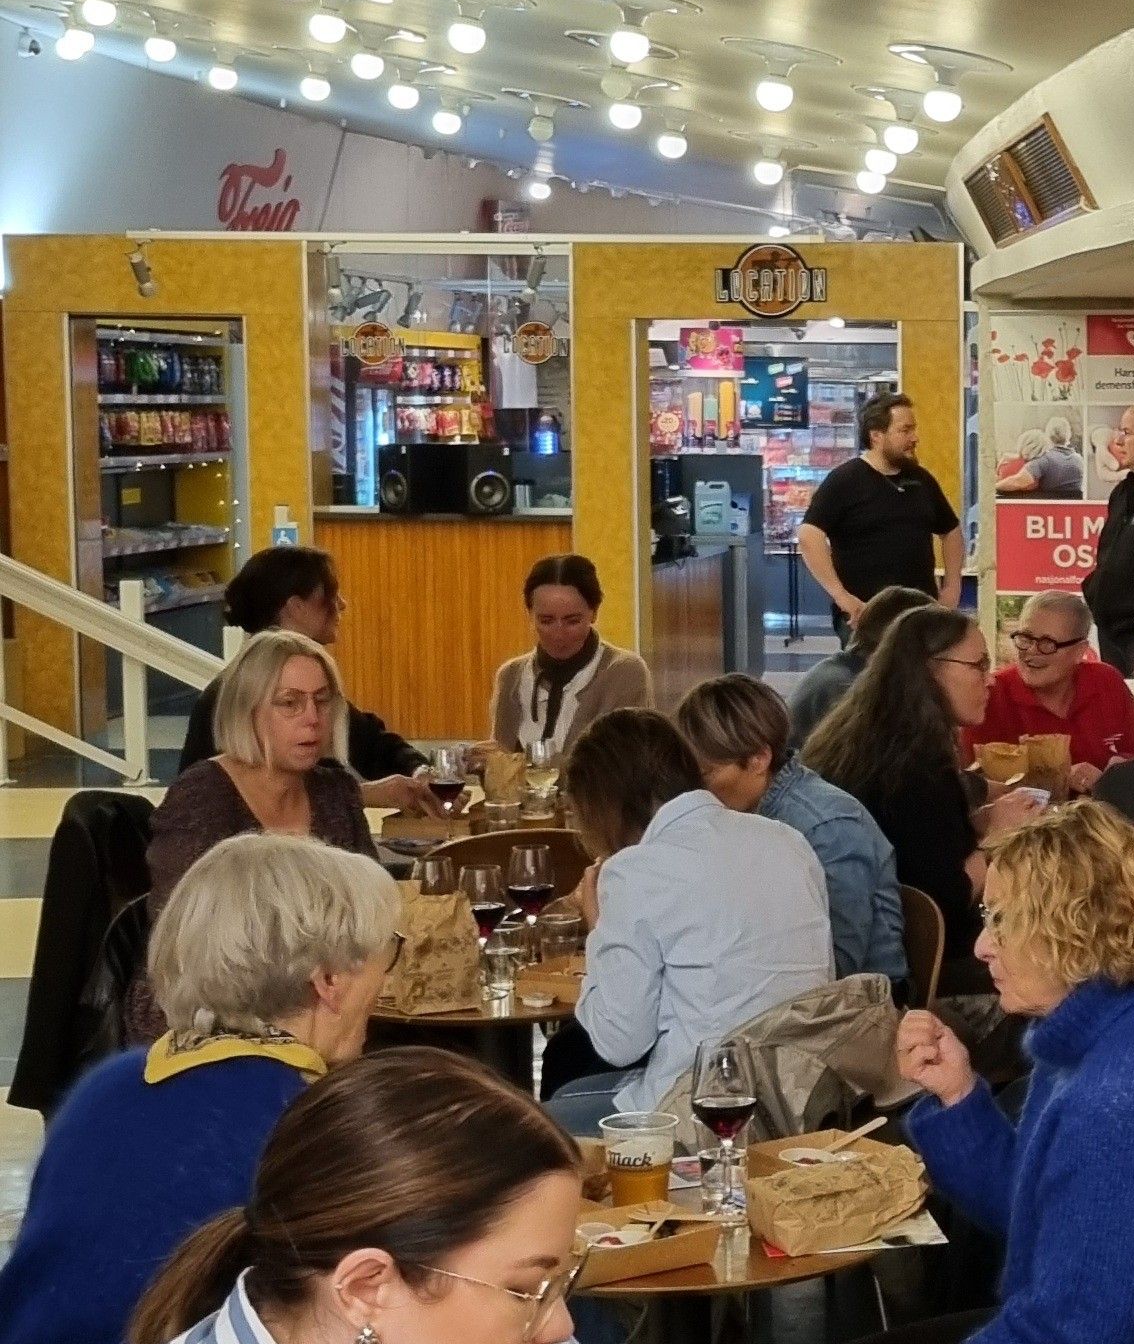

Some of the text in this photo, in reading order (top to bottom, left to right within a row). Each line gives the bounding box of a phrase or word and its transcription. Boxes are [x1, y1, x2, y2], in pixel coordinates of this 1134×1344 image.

[715, 268, 826, 302] LOCATION
[1026, 515, 1072, 539] BLI
[1083, 516, 1105, 539] M
[1053, 544, 1098, 568] OS
[608, 1150, 653, 1167] Mack
